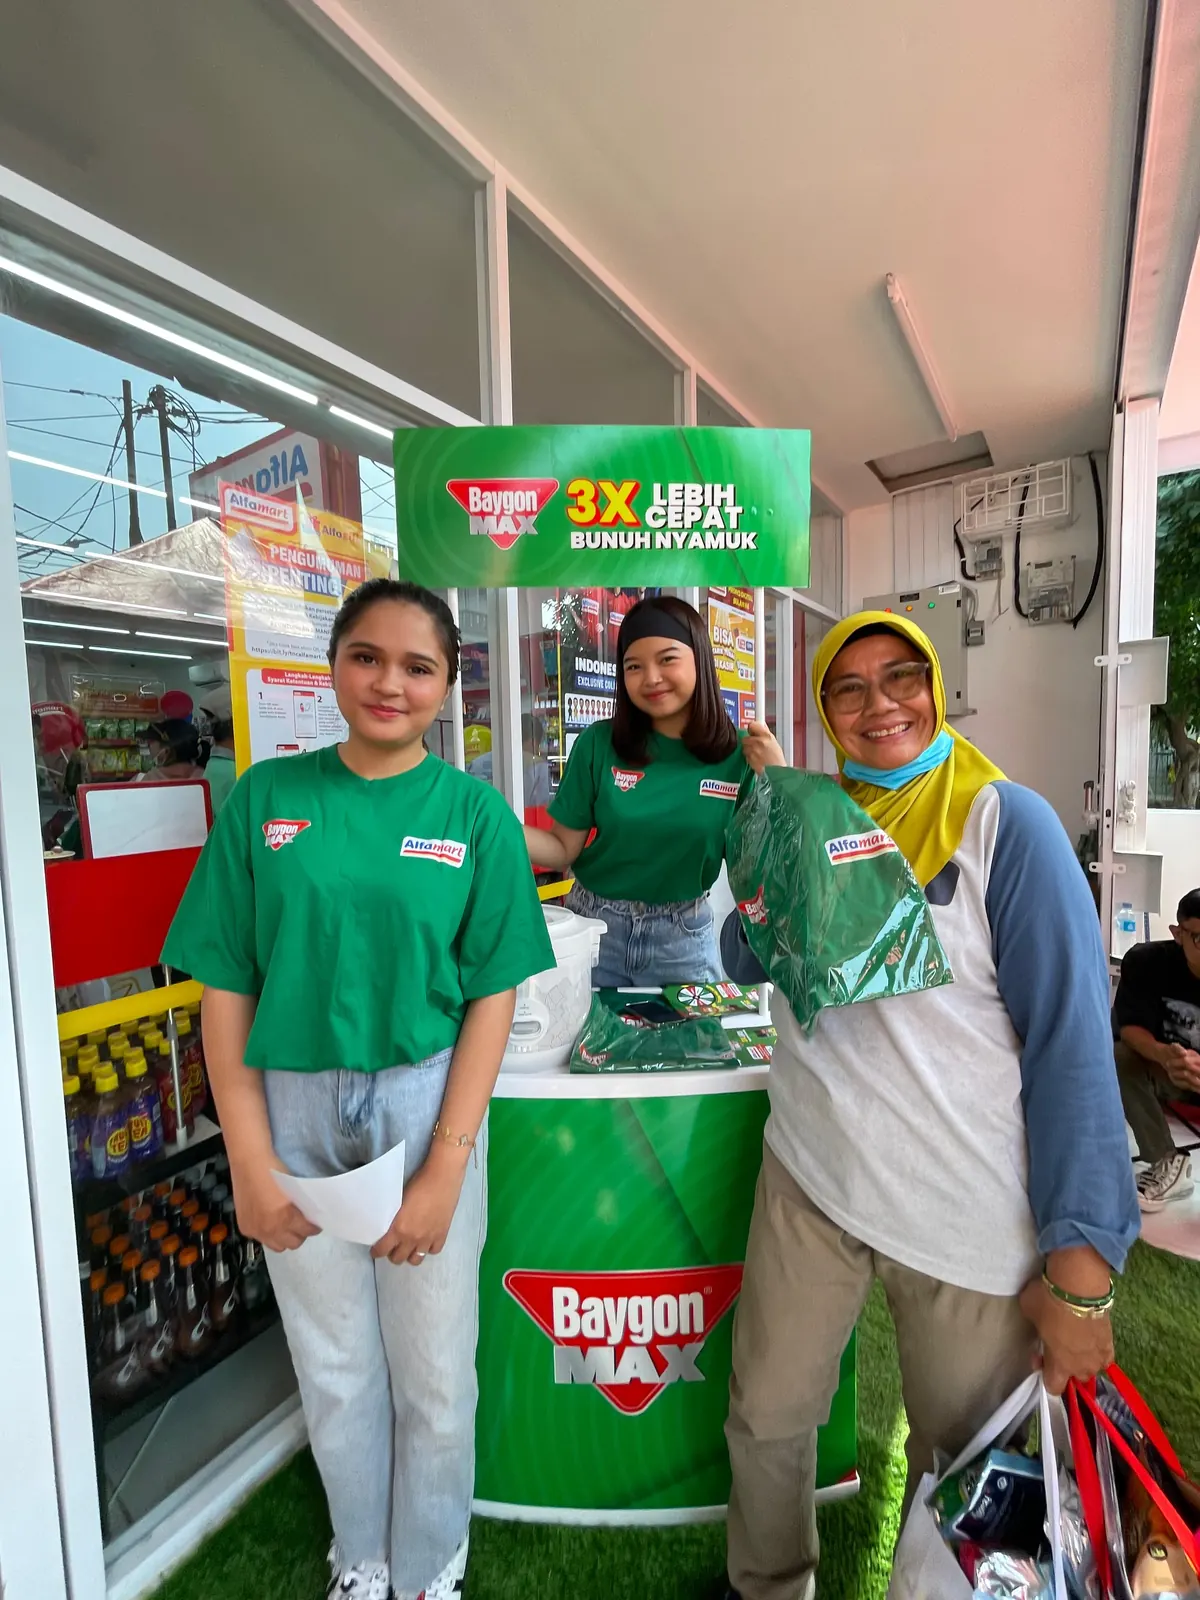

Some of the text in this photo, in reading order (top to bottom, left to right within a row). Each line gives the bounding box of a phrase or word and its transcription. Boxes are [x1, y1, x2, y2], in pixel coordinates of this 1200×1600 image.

[468, 487, 538, 516] Baygon
[565, 477, 642, 527] 3X
[653, 483, 735, 506] LEBIH
[230, 492, 289, 519] Alfamart
[469, 514, 538, 535] MAX
[645, 505, 743, 529] CEPAT
[570, 531, 758, 550] BUNUH NYAMUK
[713, 625, 734, 647] BISA
[577, 675, 604, 689] EXCLUSIVE
[258, 691, 263, 700] 1
[317, 695, 323, 703] 2
[616, 771, 638, 782] Baygon
[267, 822, 299, 837] Baygon
[265, 834, 294, 847] MAX
[404, 839, 464, 858] Alfamart
[552, 1286, 704, 1345] Baygon
[553, 1342, 706, 1385] MAX
